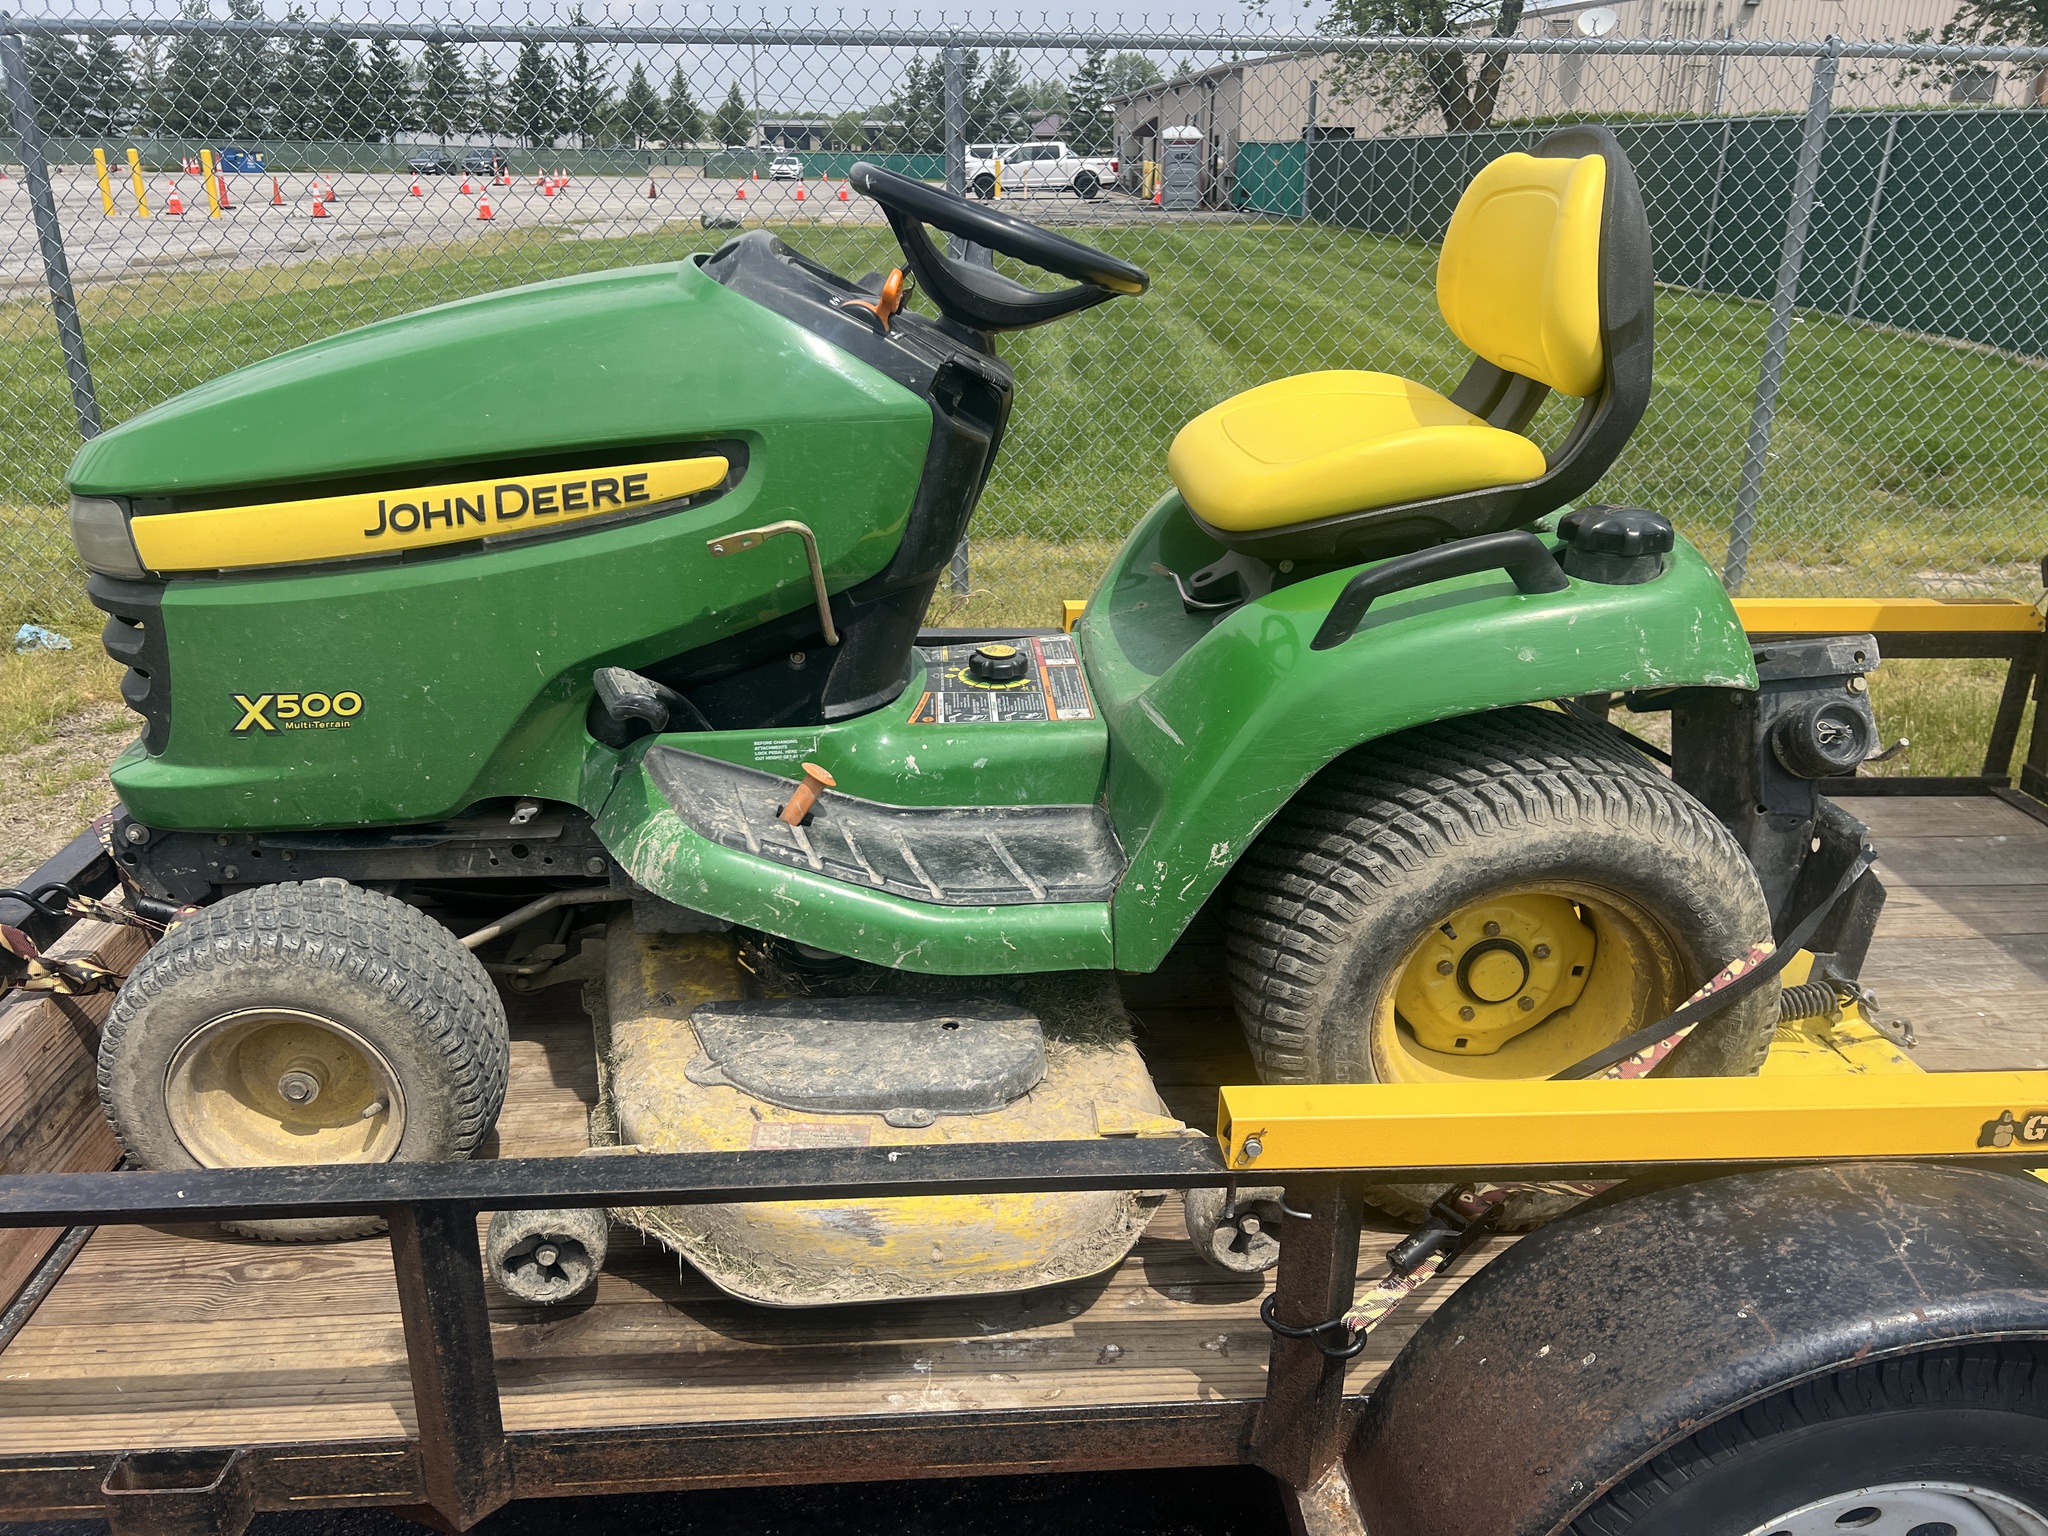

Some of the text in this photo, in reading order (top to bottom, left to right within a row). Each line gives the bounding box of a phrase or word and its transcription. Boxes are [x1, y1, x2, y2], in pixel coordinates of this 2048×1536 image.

[364, 473, 650, 536] JOHN DEERE
[231, 691, 363, 732] X500
[285, 721, 351, 730] Multi-Terrain
